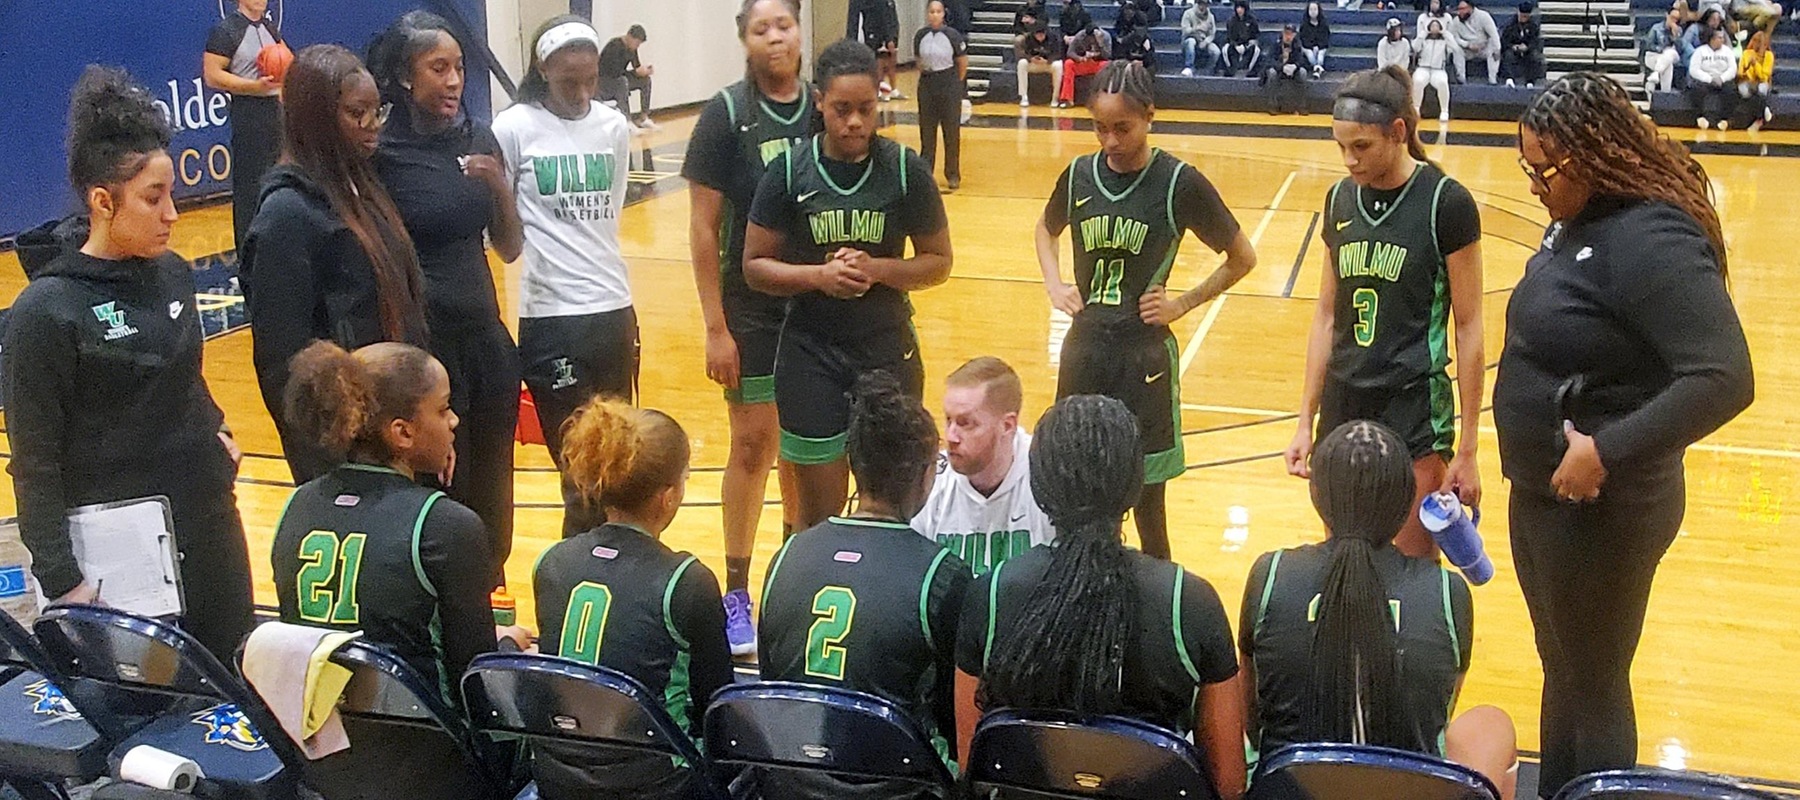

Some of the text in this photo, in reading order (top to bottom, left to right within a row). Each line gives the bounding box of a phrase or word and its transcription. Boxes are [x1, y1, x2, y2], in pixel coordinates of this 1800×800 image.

[150, 77, 232, 131] olde
[553, 207, 616, 221] BASETBLL
[808, 209, 885, 245] WILMU
[1080, 214, 1149, 255] WILMU
[1086, 258, 1125, 306] 11
[1339, 240, 1408, 283] WILMU
[91, 300, 125, 328] WU
[1352, 287, 1378, 347] 3
[296, 529, 368, 624] 21
[558, 580, 612, 666] 0
[804, 585, 857, 681] 2
